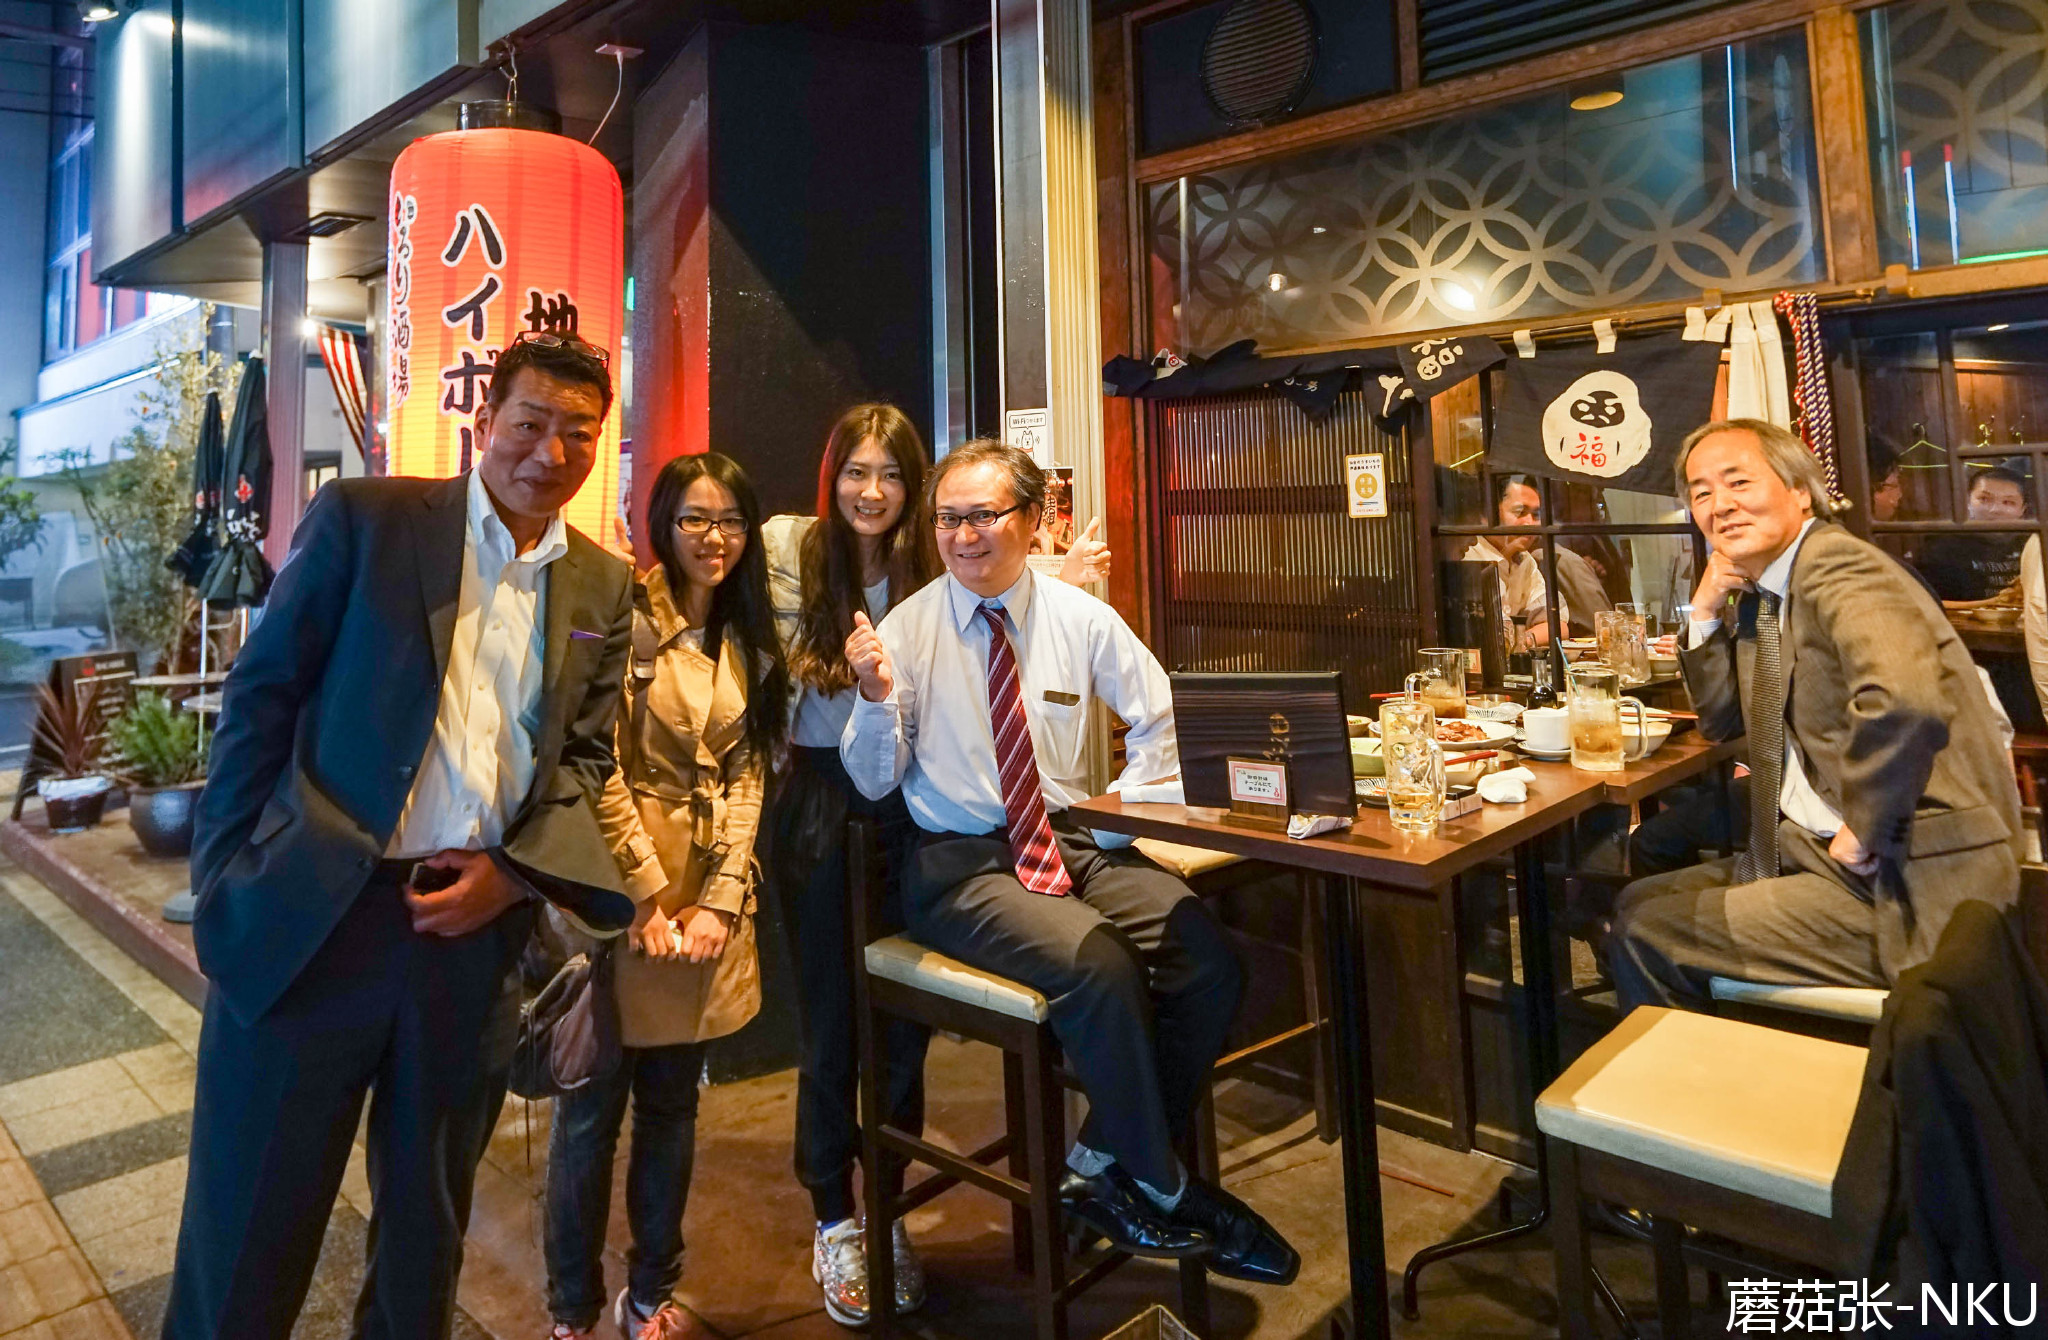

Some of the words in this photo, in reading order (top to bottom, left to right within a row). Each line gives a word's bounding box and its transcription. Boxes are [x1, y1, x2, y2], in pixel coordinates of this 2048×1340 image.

[392, 194, 415, 404] いろり酒場
[1569, 432, 1607, 468] 福
